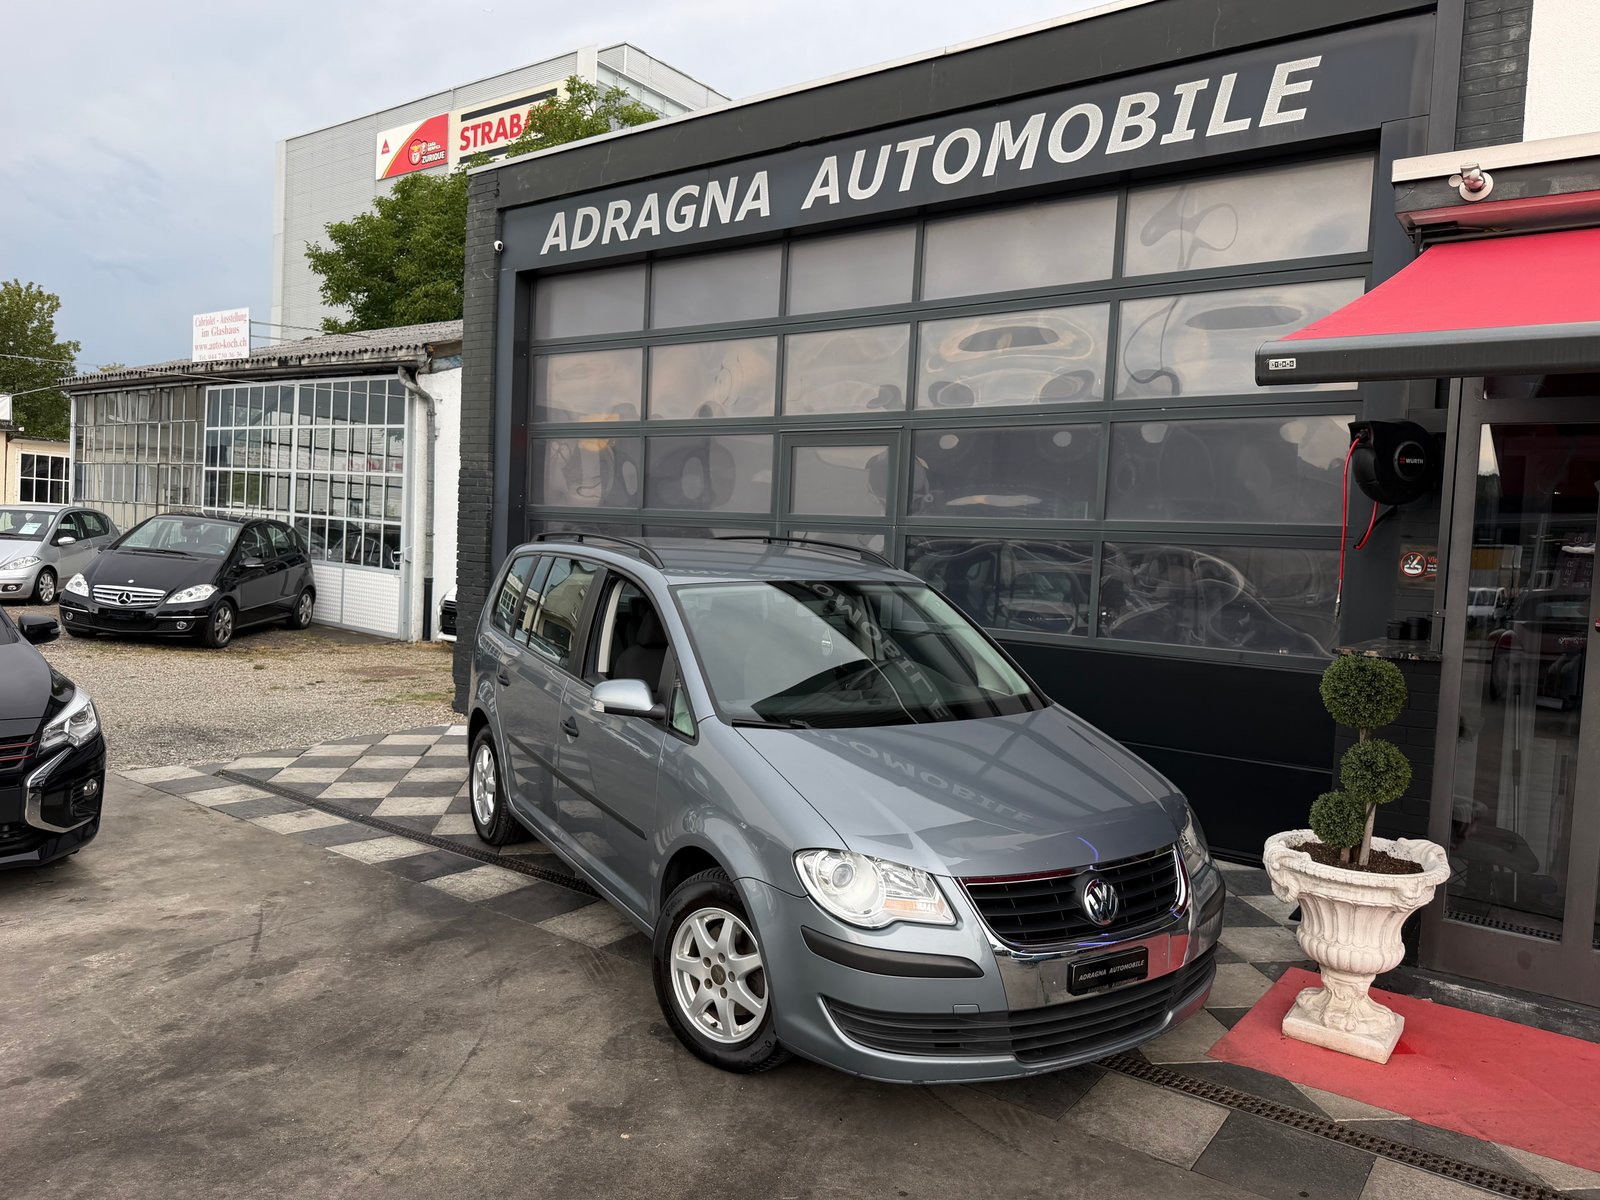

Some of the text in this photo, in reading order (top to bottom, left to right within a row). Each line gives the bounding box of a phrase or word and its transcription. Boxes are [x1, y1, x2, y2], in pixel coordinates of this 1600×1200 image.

[460, 105, 550, 151] STRAB
[422, 151, 445, 163] ZURIQUE
[540, 55, 1322, 255] ADRAGNA AUTOMOBILE
[201, 328, 210, 338] im
[1078, 959, 1145, 982] ADRAGNA AUTOMOBILE
